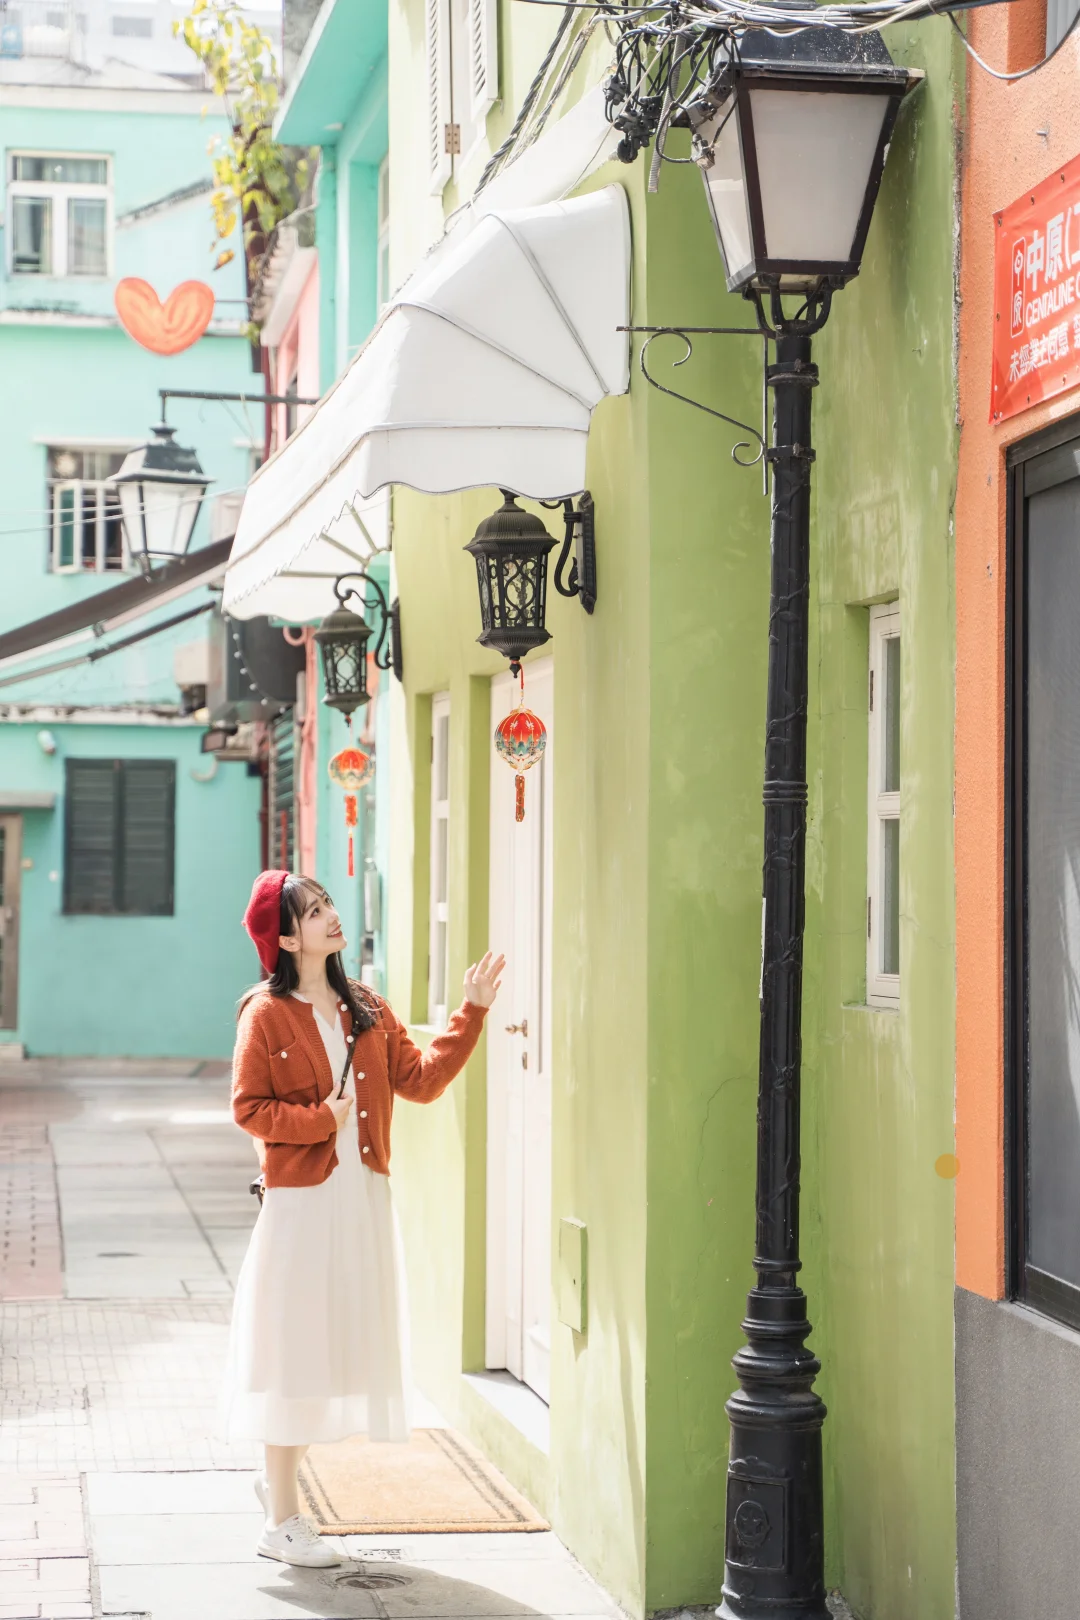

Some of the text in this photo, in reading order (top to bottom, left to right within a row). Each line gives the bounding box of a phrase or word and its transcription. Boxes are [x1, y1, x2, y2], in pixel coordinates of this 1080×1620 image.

[1026, 276, 1075, 328] CENTALINE
[1009, 321, 1069, 382] 未經業主同意
